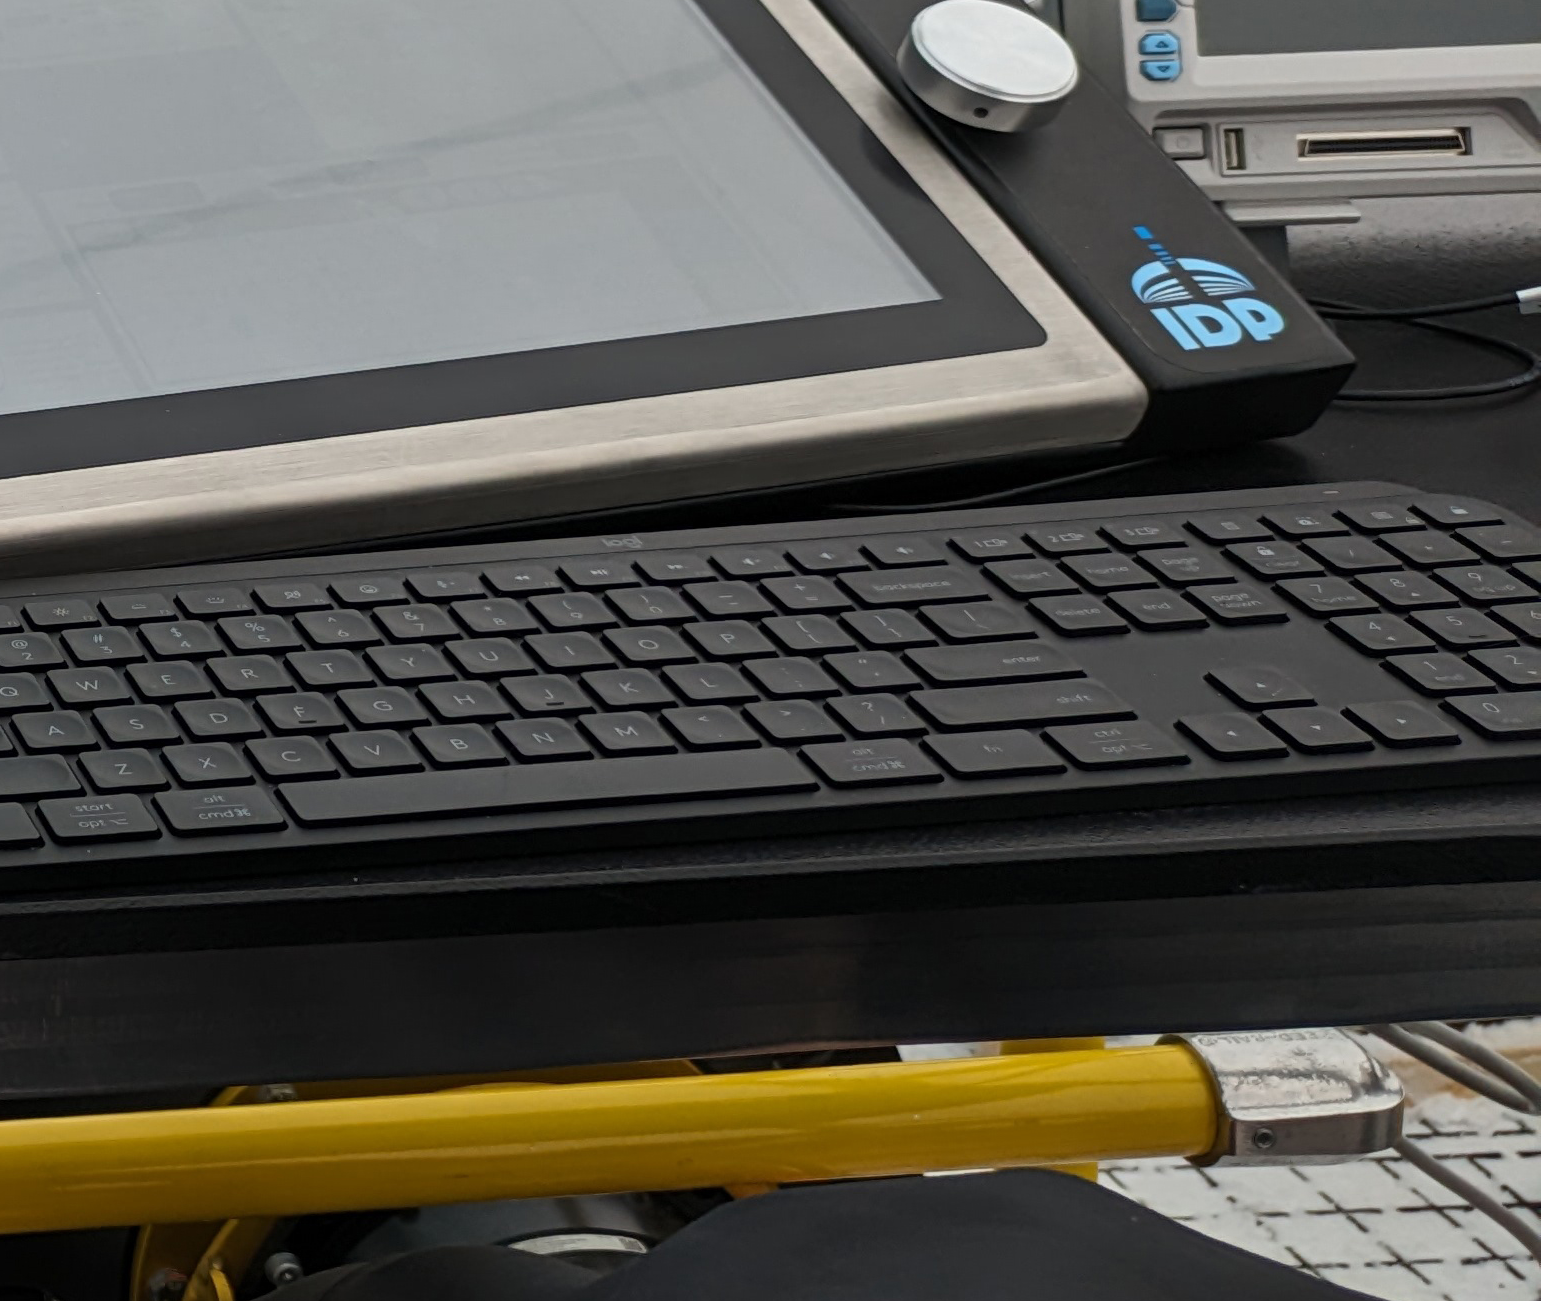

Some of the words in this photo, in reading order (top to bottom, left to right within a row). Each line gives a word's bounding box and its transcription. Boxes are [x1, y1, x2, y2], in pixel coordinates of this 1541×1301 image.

[602, 534, 643, 549] logi
[872, 579, 953, 593] backspace
[1388, 578, 1407, 588] 8
[1369, 620, 1382, 632] 4
[1445, 615, 1463, 626] 5
[11, 638, 29, 650] @
[719, 633, 735, 644] P
[637, 639, 660, 651] O
[21, 651, 35, 662] 2
[400, 656, 416, 668] Y
[478, 650, 499, 662] U
[1001, 654, 1042, 665] enter
[1504, 654, 1524, 666] 2
[319, 661, 335, 674] T
[160, 674, 177, 686] E
[240, 668, 259, 680] R
[75, 679, 100, 692] W
[618, 681, 639, 694] K
[699, 677, 716, 689] L
[452, 694, 476, 706] H
[543, 688, 555, 701] J
[292, 705, 306, 718] F
[372, 700, 394, 712] G
[128, 718, 145, 731] S
[208, 712, 229, 725] D
[47, 724, 66, 737] A
[613, 725, 639, 738] M
[449, 737, 469, 750] B
[531, 732, 555, 744] N
[363, 744, 381, 757] V
[197, 756, 217, 769] X
[280, 751, 302, 763] C
[114, 763, 134, 776] Z
[203, 793, 226, 804] alt
[74, 802, 115, 813] start
[78, 817, 107, 830] opt
